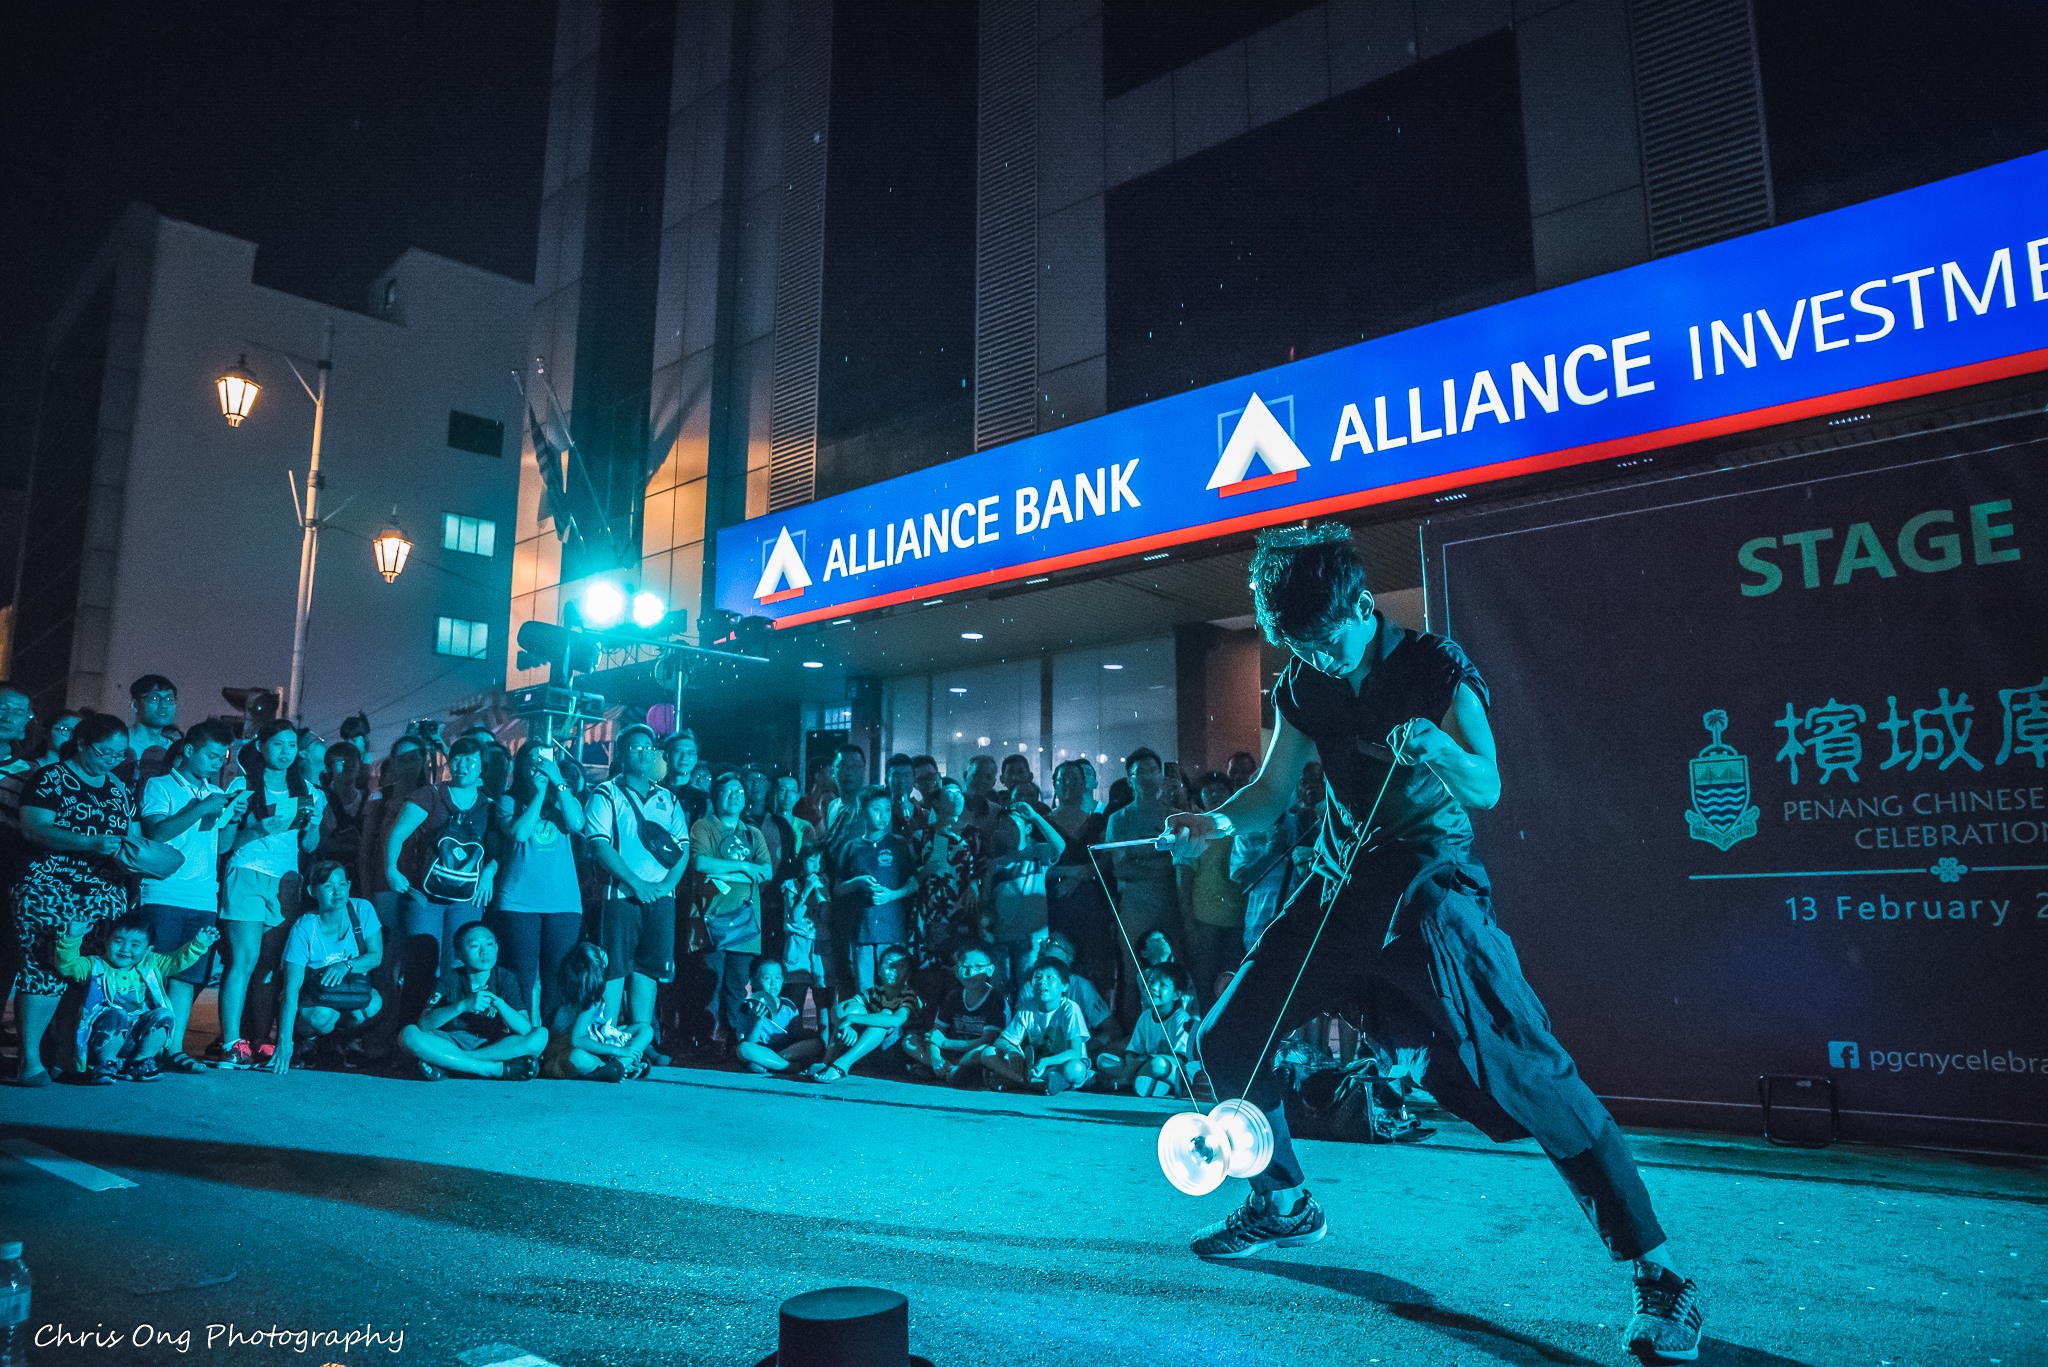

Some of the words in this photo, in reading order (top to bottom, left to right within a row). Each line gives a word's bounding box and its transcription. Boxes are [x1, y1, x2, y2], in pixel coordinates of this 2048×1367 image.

[1330, 331, 1655, 462] ALLIANCE
[823, 495, 1000, 582] ALLIANCE
[1015, 458, 1141, 535] BANK
[1738, 499, 2021, 597] STAGE
[1783, 795, 1903, 822] PENANG
[1912, 787, 2046, 815] CHINESE
[1785, 896, 1818, 921] 13
[1837, 894, 2010, 926] February
